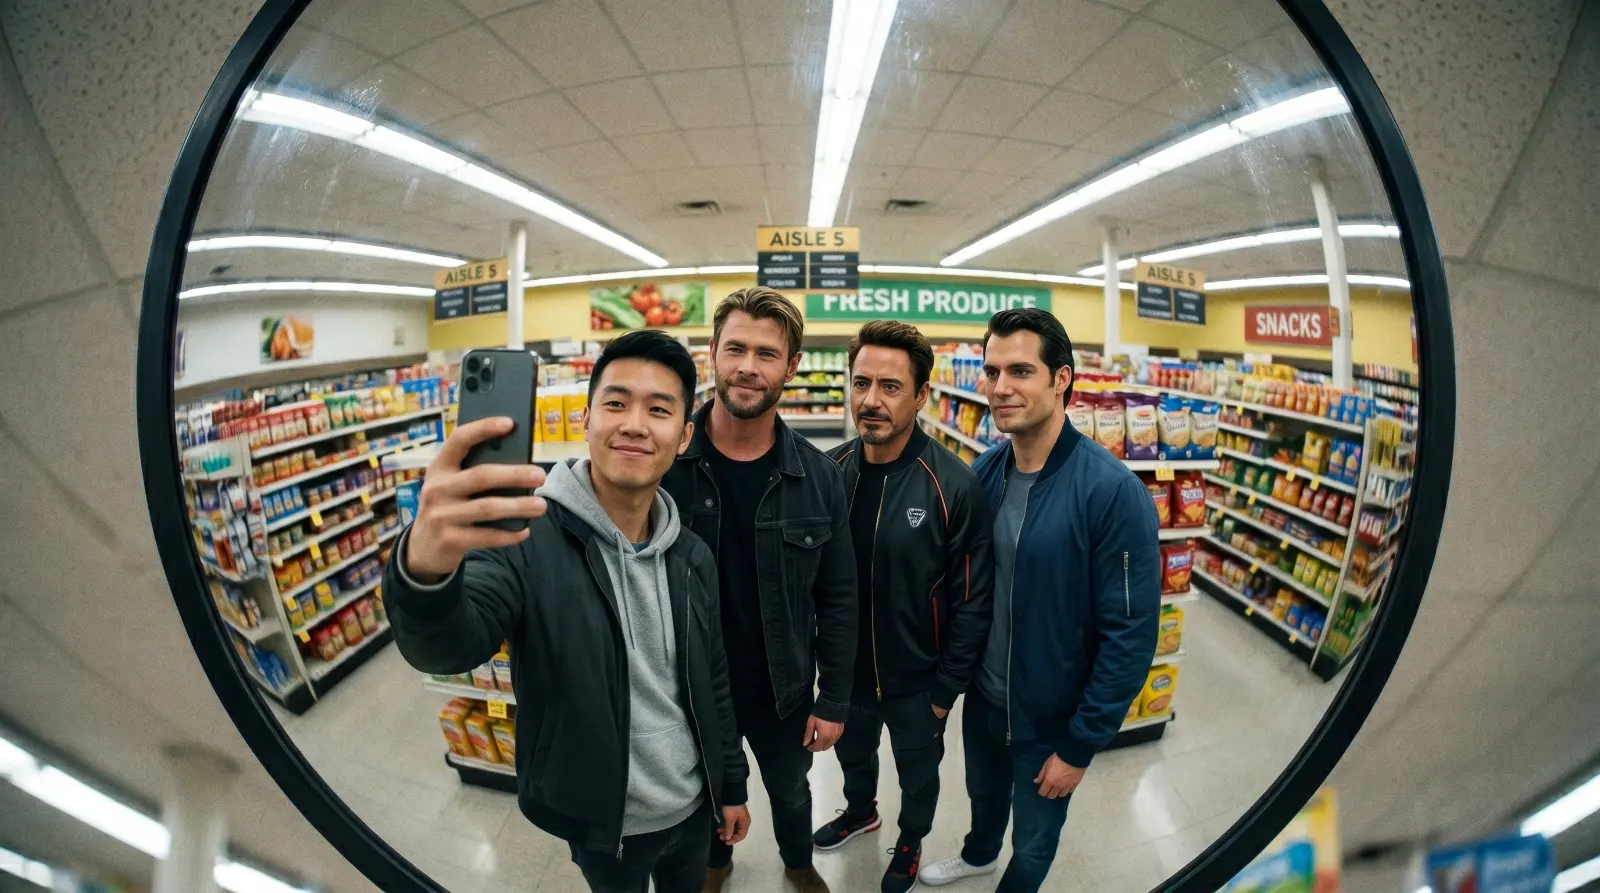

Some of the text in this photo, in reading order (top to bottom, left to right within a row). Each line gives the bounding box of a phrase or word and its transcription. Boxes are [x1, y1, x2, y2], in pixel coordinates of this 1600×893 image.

[770, 231, 845, 246] AISLE 5
[444, 264, 482, 284] AISLE
[1147, 265, 1184, 283] AISLE
[823, 288, 1037, 315] FRESH PRODUCE
[1256, 312, 1322, 339] SNACKS
